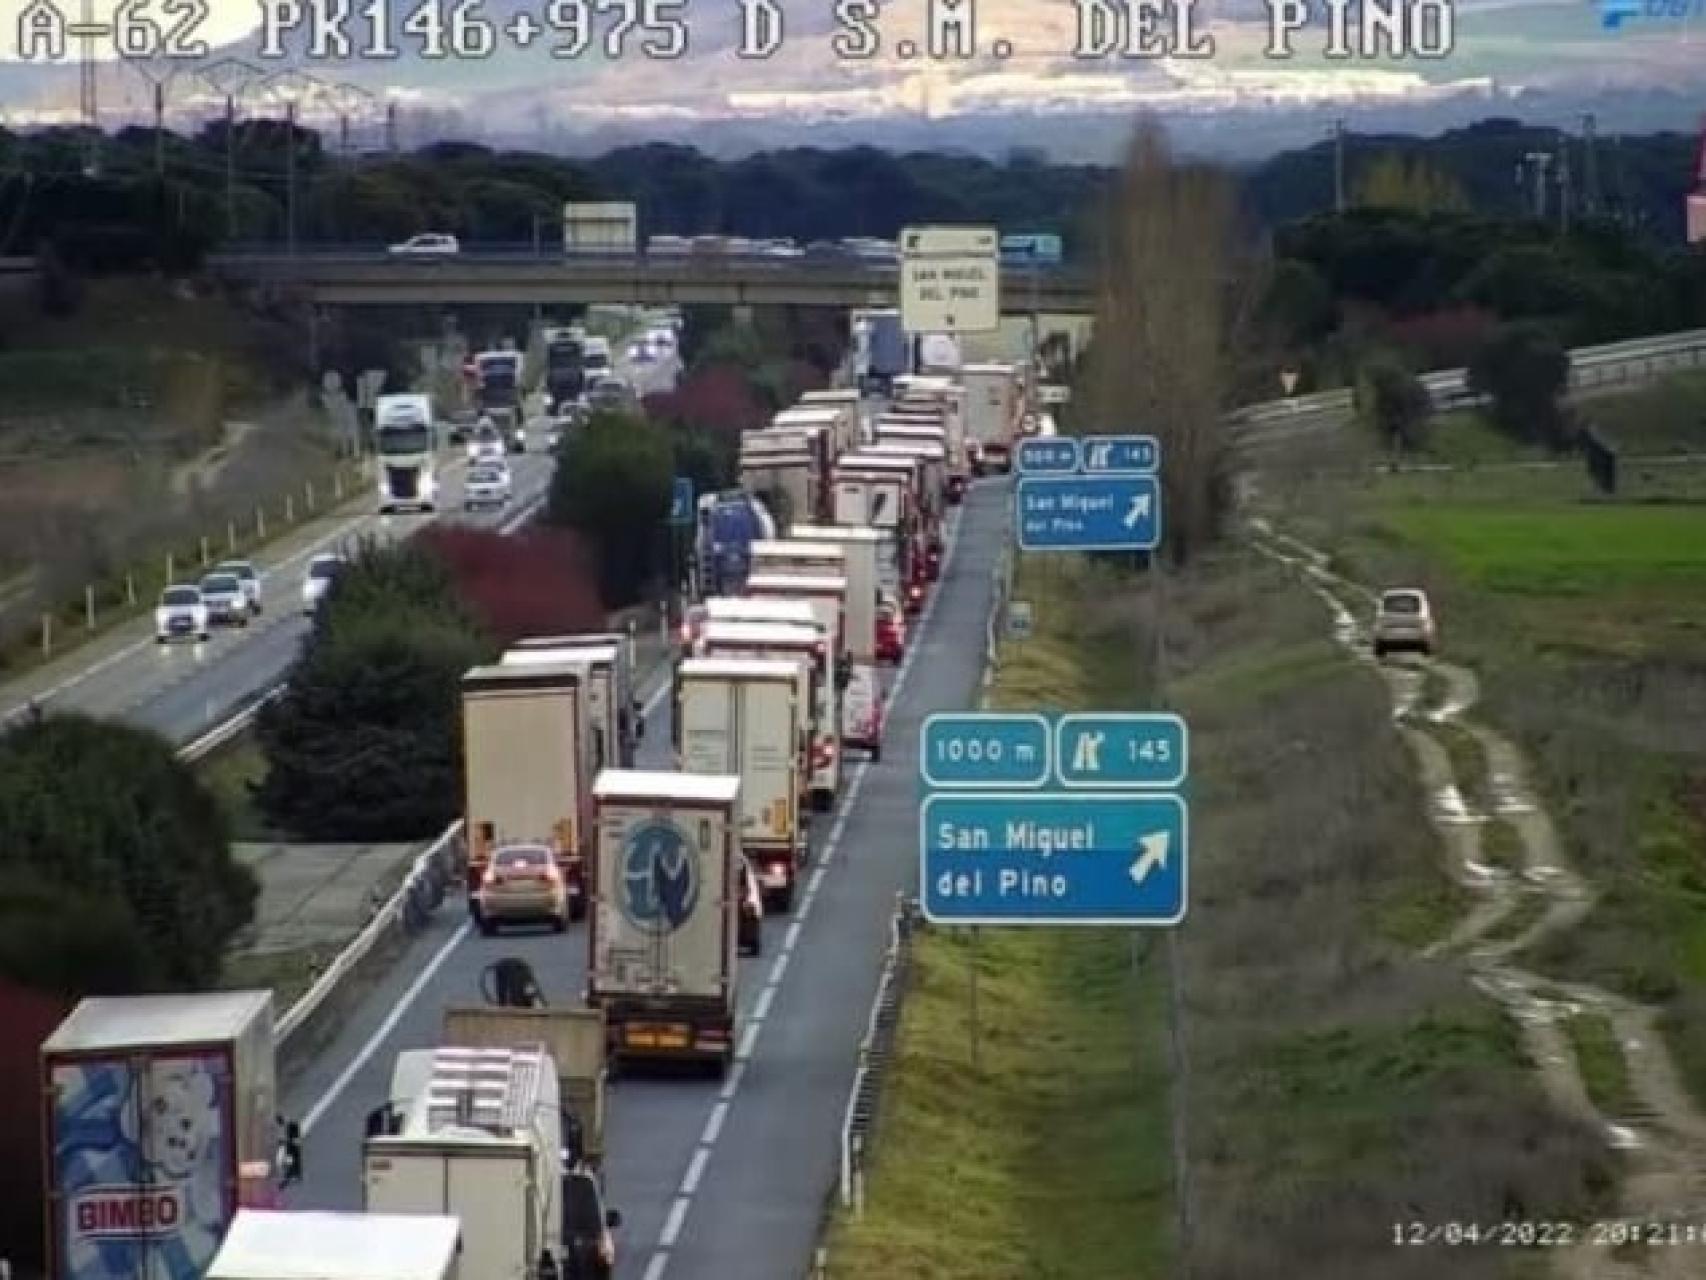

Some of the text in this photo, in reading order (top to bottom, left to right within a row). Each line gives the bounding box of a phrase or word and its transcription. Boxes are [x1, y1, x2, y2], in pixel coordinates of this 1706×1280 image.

[936, 738, 1036, 761] 1000 m
[1128, 739, 1171, 763] 145
[938, 821, 1095, 857] San Miguel
[937, 868, 1067, 896] del Pino
[77, 1197, 178, 1232] BIMBO
